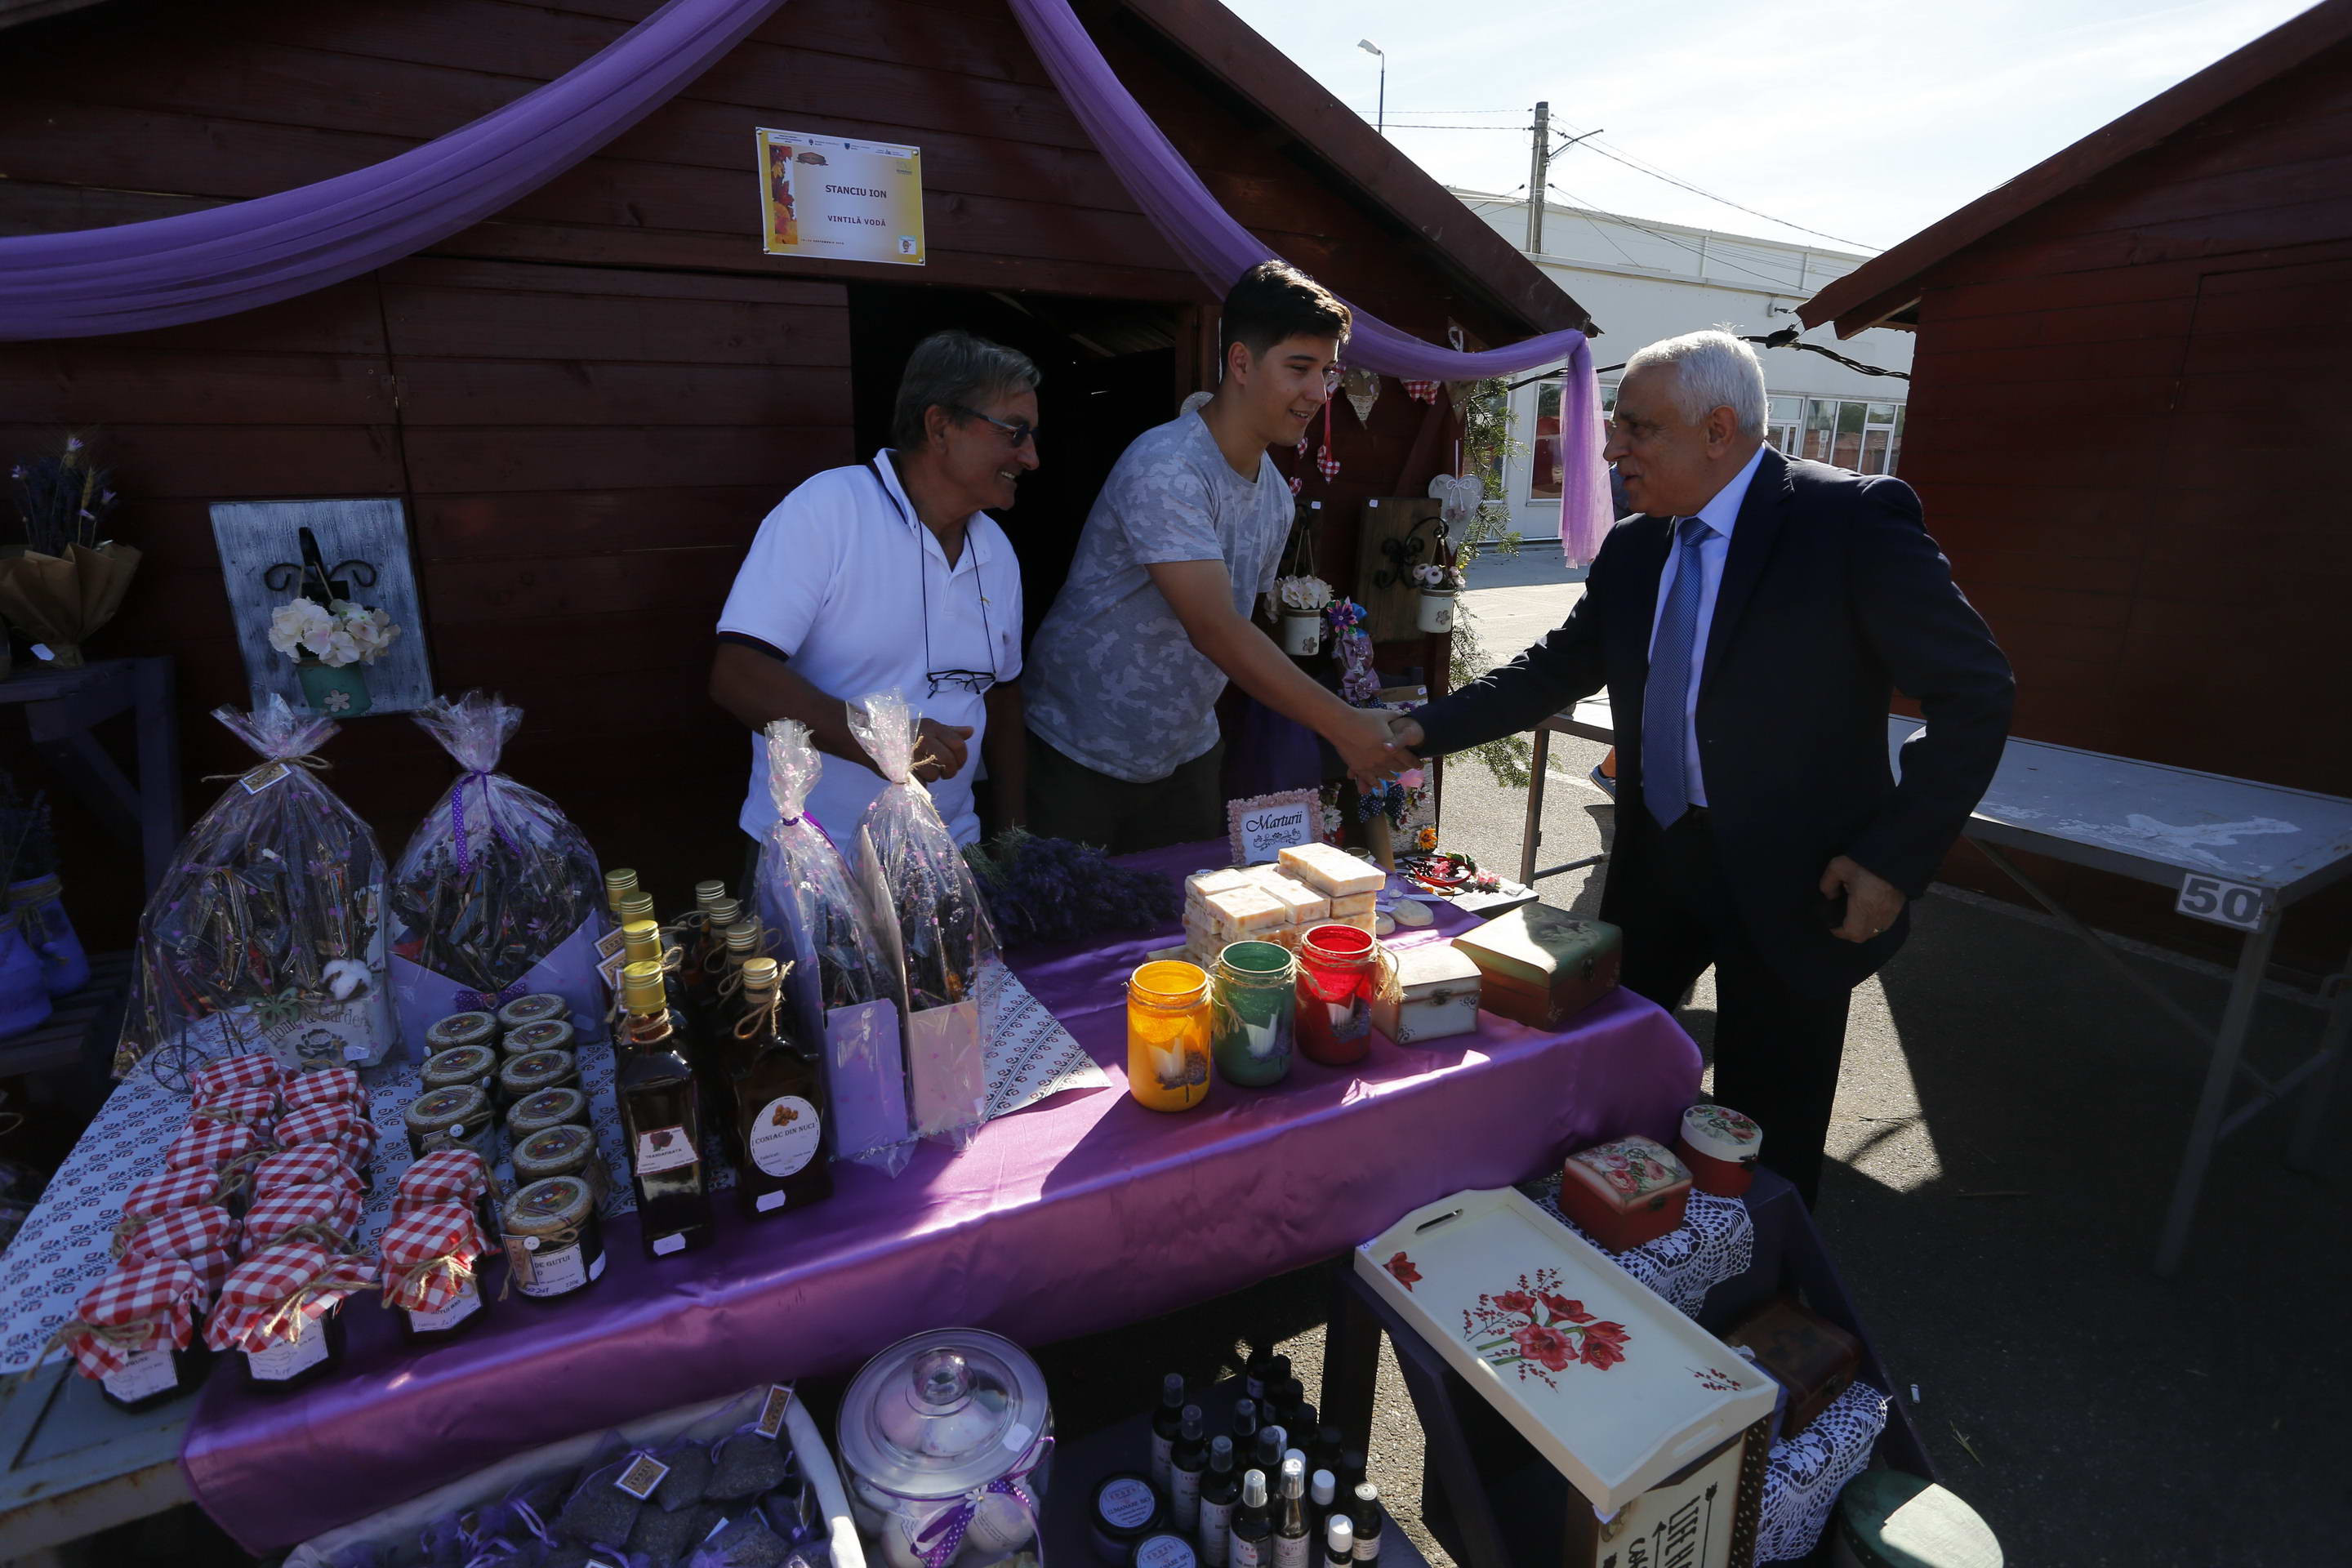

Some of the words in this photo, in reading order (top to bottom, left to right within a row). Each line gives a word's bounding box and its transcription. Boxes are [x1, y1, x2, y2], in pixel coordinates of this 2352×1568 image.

[825, 185, 866, 198] STANCIU
[869, 188, 887, 198] ION
[827, 215, 862, 225] VINTILĂ
[1246, 811, 1303, 832] Marturii
[2181, 877, 2263, 924] 50
[263, 1019, 302, 1046] Home
[304, 1013, 316, 1024] &
[755, 1132, 784, 1144] CONIAC
[785, 1128, 797, 1137] DIN
[799, 1122, 815, 1132] NUCI
[546, 1254, 571, 1267] GUTUI
[1665, 1495, 1700, 1556] LIFE
